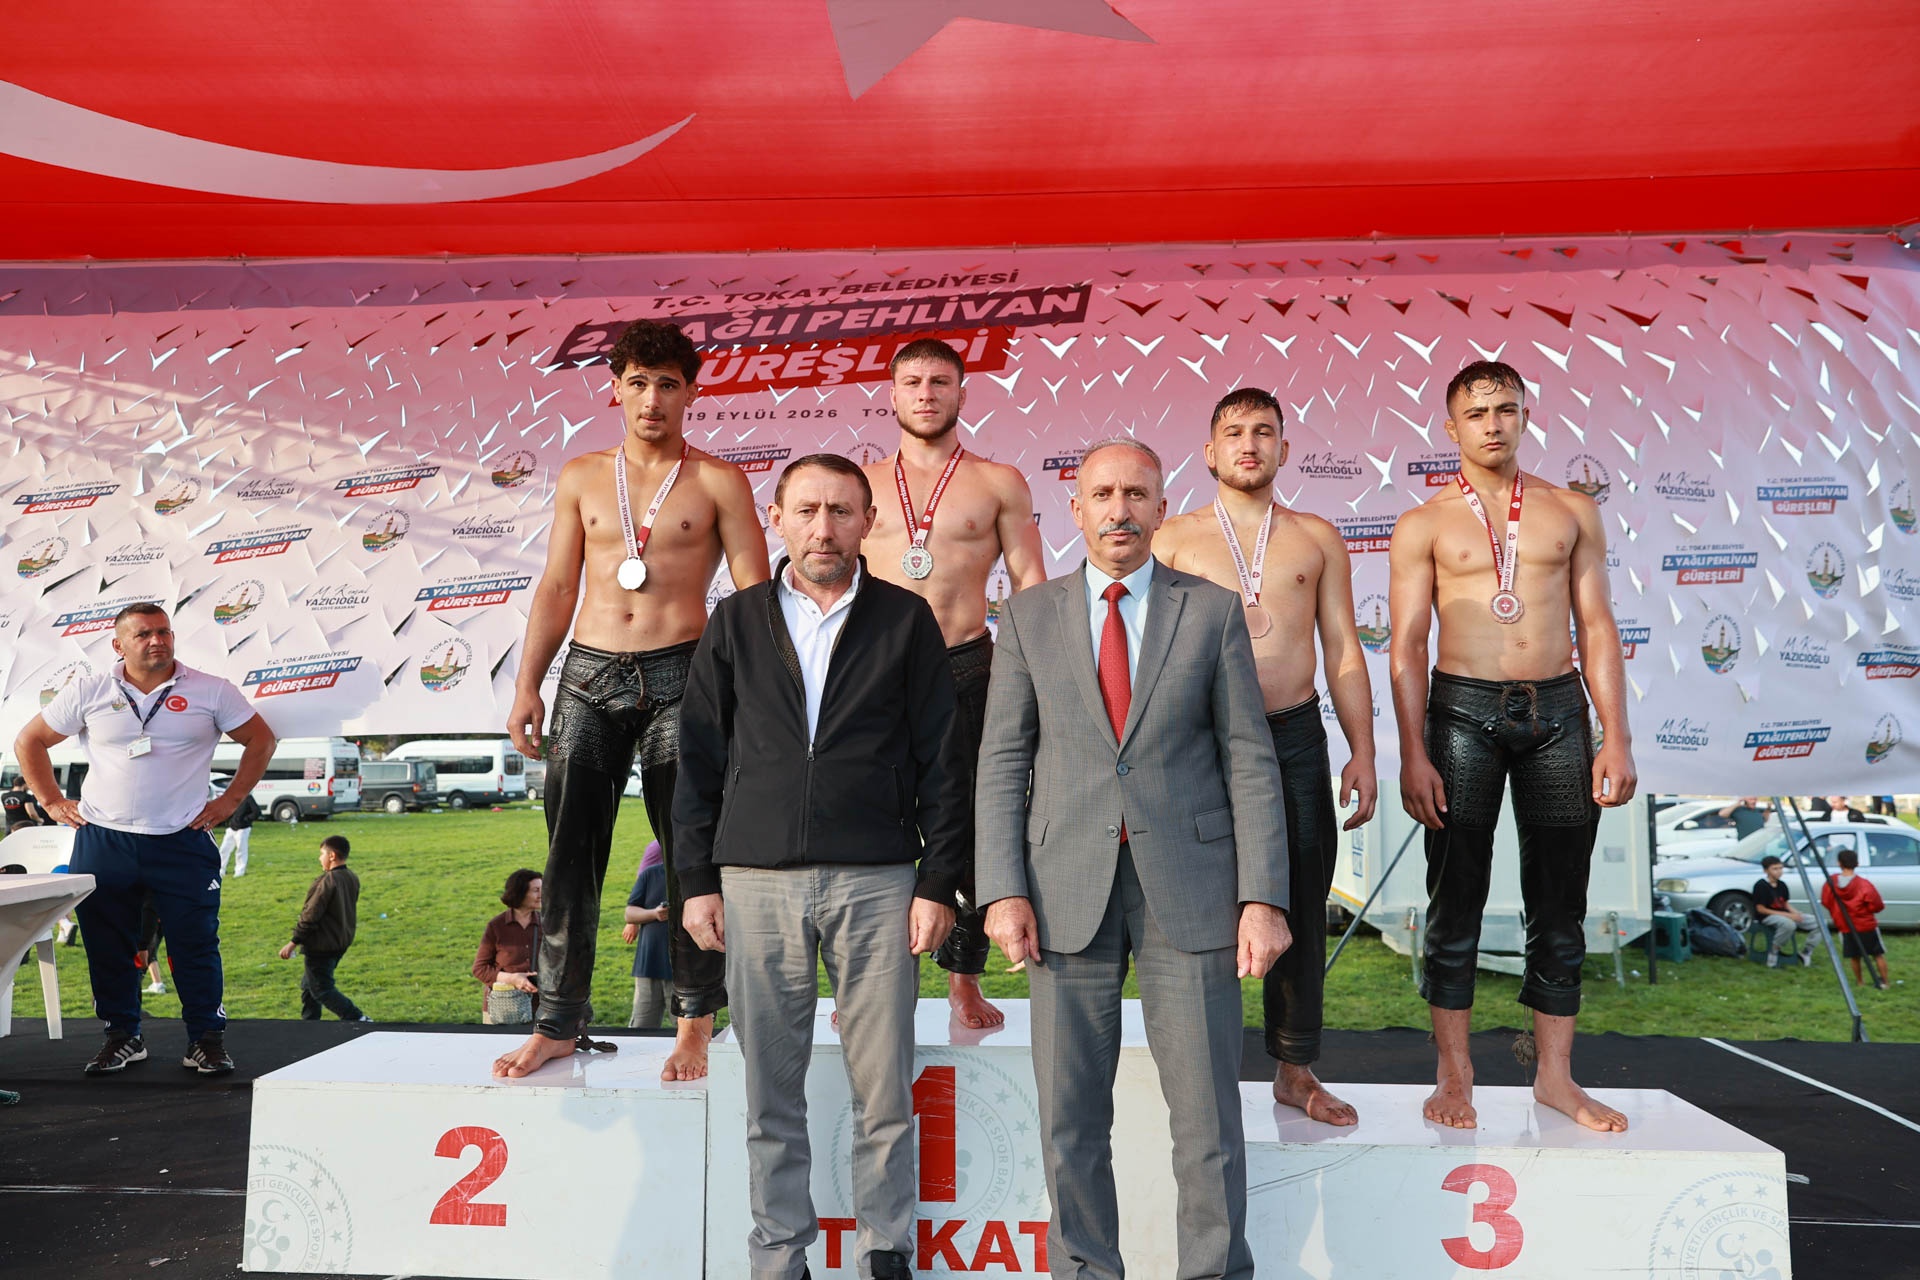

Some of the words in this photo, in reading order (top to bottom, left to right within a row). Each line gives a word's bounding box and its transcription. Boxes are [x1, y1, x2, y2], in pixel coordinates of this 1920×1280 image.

[652, 296, 711, 310] T.C.
[724, 287, 837, 301] TOKAT
[840, 268, 1020, 295] BELEDİYESİ
[680, 311, 797, 342] AĞLI
[804, 291, 1081, 334] PEHLİVAN
[687, 411, 705, 421] 19
[717, 408, 777, 421] EYLÜL
[788, 408, 838, 419] 2026
[740, 443, 778, 451] BELEDİYESİ
[731, 450, 788, 462] PEHLİVAN
[1298, 465, 1362, 475] YAZICIOĞLU
[1409, 464, 1420, 473] 2.
[1421, 460, 1451, 472] YAĞLI
[383, 468, 437, 481] PEHLİVAN
[63, 486, 116, 499] PEHLİVAN
[351, 480, 415, 495] GÜREŞLERİ
[1654, 485, 1715, 497] YAZICIOĞLU
[1758, 489, 1768, 497] 2.
[1768, 487, 1798, 498] YAĞLI
[1798, 485, 1848, 497] PEHLİVAN
[29, 497, 94, 512] GÜREŞLERİ
[1775, 500, 1832, 514] GÜREŞLERİ
[622, 506, 632, 538] GELENEKSEL
[1359, 514, 1397, 523] BELEDİYESİ
[254, 530, 309, 545] PEHLİVAN
[452, 525, 515, 535] YAZICIOĞLU
[1356, 524, 1394, 536] PEHLİV
[220, 544, 285, 561] GÜREŞLERİ
[1664, 558, 1674, 566] 2.
[1675, 554, 1705, 566] YAĞLI
[1705, 552, 1756, 565] PEHLİVAN
[453, 574, 477, 582] TOKAT
[477, 569, 519, 580] BELEDİYESİ
[1681, 568, 1741, 584] GÜREŞLERİ
[433, 584, 469, 596] YAĞLI
[468, 578, 529, 593] PEHLİVAN
[305, 595, 369, 606] YAZICIOĞLU
[434, 591, 504, 608] GÜREŞLERİ
[1359, 594, 1374, 609] TOKAT
[57, 614, 68, 623] 2.
[71, 609, 104, 621] YAĞLI
[429, 638, 452, 653] TOKAT
[282, 655, 308, 664] TOKAT
[308, 650, 350, 660] BELEDİYESİ
[1779, 651, 1830, 664] YAZICIOĞLU
[247, 673, 258, 682] 2.
[260, 667, 299, 680] YAĞLI
[299, 659, 358, 674] PEHLİVAN
[261, 675, 333, 694] GÜREŞLERİ
[1656, 733, 1709, 746] YAZICIOĞLU
[1757, 732, 1786, 742] YAĞLI
[1786, 729, 1828, 741] PEHLİVAN
[1758, 743, 1811, 758] GÜREŞLERİ
[912, 1065, 956, 1202] 1
[979, 1107, 994, 1126] VE
[992, 1126, 1009, 1169] SPOR
[430, 1126, 508, 1227] 2
[269, 1179, 312, 1210] GENÇLİK
[307, 1209, 320, 1226] VE
[1440, 1164, 1524, 1270] 3
[1700, 1207, 1748, 1235] GENÇLİK
[1753, 1208, 1767, 1221] VE
[310, 1227, 321, 1258] SPOR
[818, 1218, 1050, 1273] TKAT
